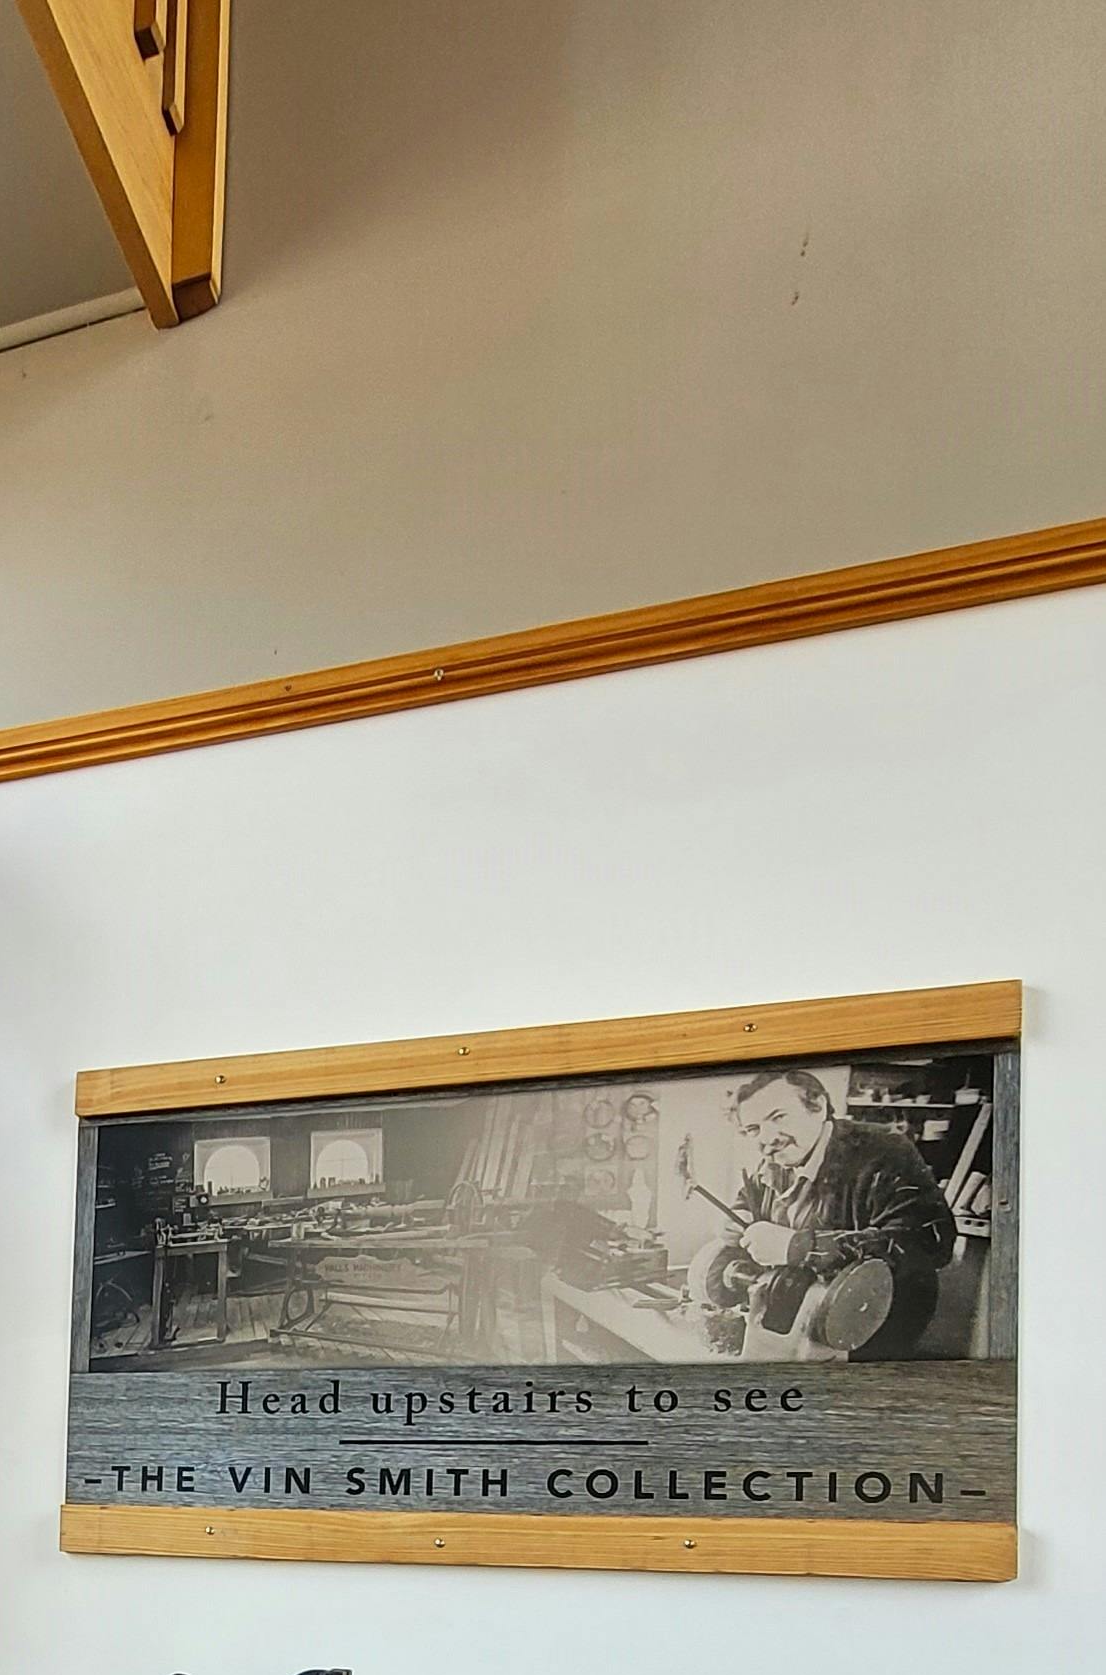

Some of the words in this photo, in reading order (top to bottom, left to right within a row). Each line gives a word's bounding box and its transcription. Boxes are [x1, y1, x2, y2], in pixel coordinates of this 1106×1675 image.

[215, 1380, 342, 1415] Head
[370, 1380, 593, 1426] upstairs
[626, 1384, 679, 1413] to
[713, 1387, 805, 1413] see
[228, 1466, 311, 1494] VIN
[345, 1466, 509, 1497] SMITH
